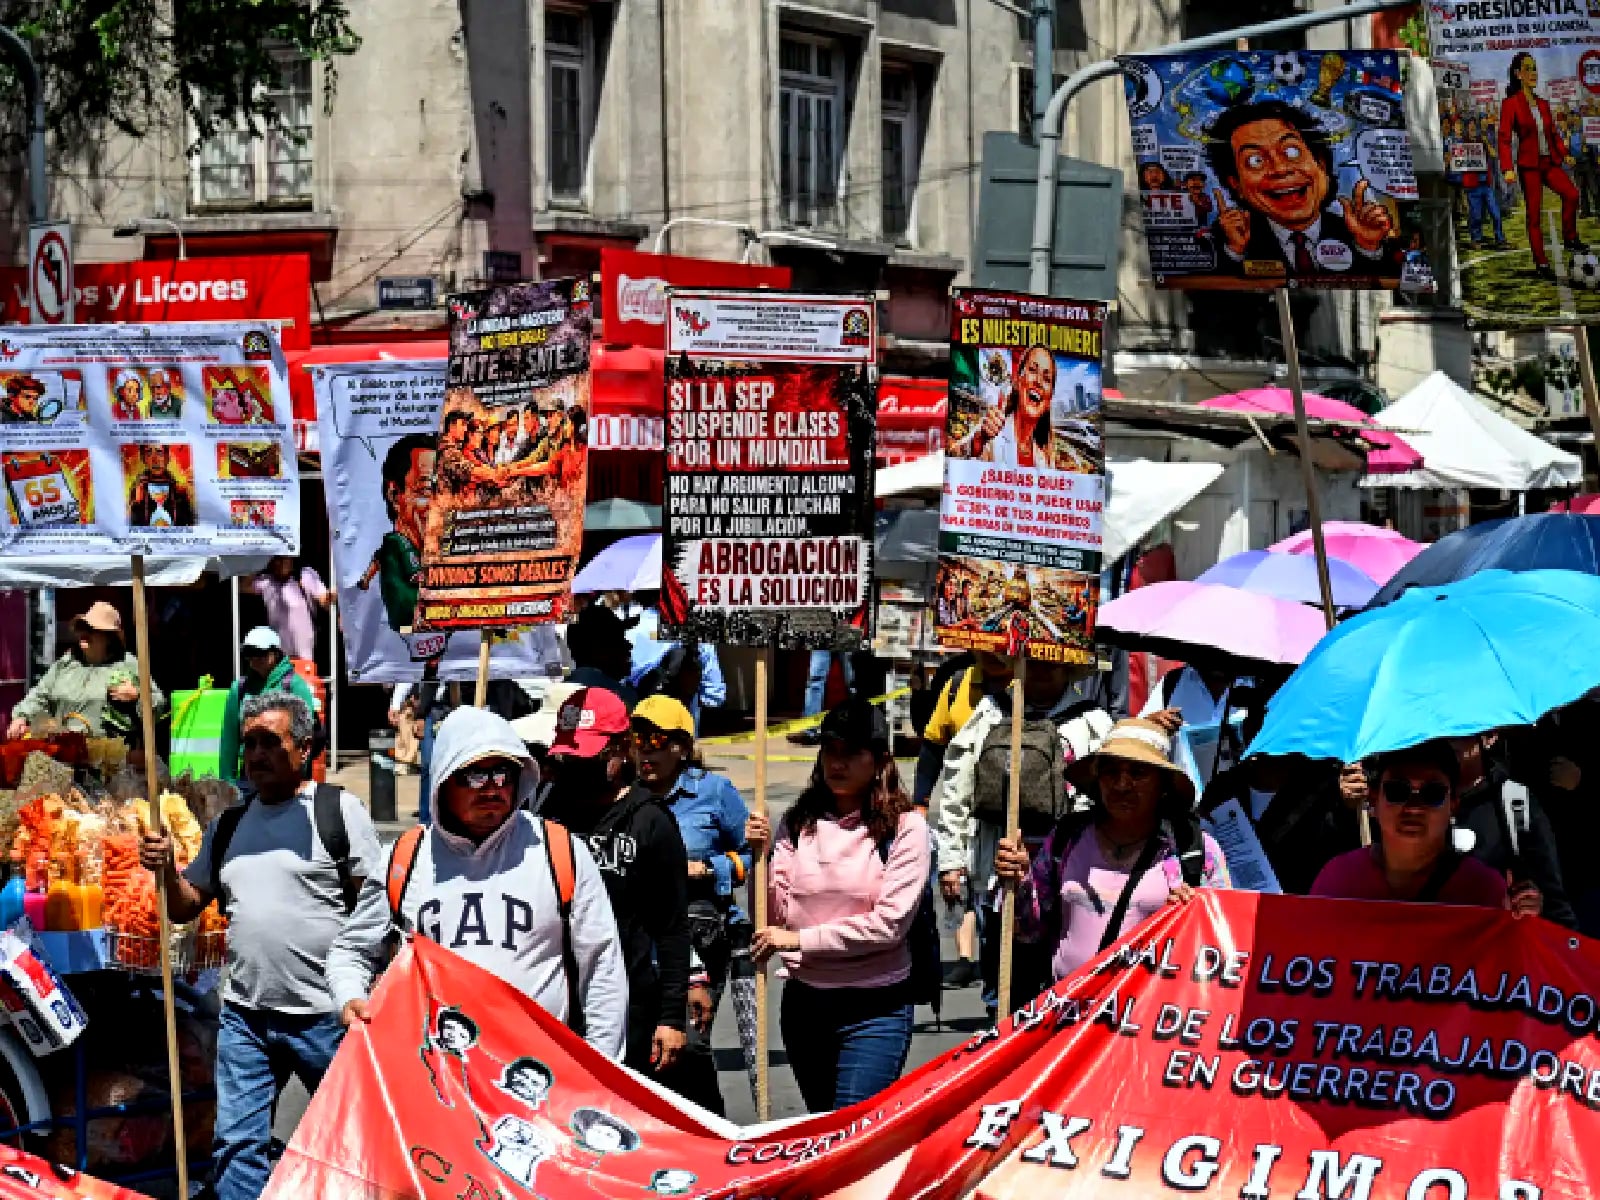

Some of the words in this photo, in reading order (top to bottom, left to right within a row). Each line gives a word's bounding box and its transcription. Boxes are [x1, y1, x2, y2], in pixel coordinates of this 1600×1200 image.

[108, 282, 126, 309] y
[134, 276, 248, 304] Licores
[961, 318, 980, 344] ES
[982, 319, 1048, 346] NUESTRO
[670, 382, 691, 411] SI
[700, 382, 727, 411] LA
[735, 382, 775, 411] SEP
[670, 411, 768, 439] SUSPENDE
[774, 411, 839, 438] CLASES
[671, 439, 711, 466] POR
[717, 439, 741, 466] UN
[748, 439, 849, 466] MUNDIAL...
[670, 475, 689, 493] NO
[692, 475, 718, 493] HAY
[720, 475, 799, 494] ARGUMENTO
[801, 475, 856, 493] ALGUNO
[981, 468, 1034, 488] ¿SABÍAS
[24, 478, 61, 507] 65
[670, 497, 706, 514] PARA
[711, 497, 730, 514] NO
[733, 497, 770, 514] SALIR
[774, 497, 784, 514] A
[787, 497, 841, 514] LUCHAR
[956, 485, 1015, 503] GOBIERNO
[1019, 492, 1033, 504] YA
[1035, 494, 1072, 510] PUEDE
[670, 516, 701, 536] POR
[705, 516, 721, 534] LA
[968, 517, 1001, 532] OBRAS
[1002, 520, 1014, 532] DE
[994, 504, 1009, 518] DE
[1011, 506, 1034, 521] TUS
[1035, 511, 1091, 529] AHORROS
[698, 537, 859, 575] ABROGACIÓN
[480, 563, 518, 584] SOMOS
[697, 578, 721, 605] ES
[728, 578, 752, 604] LA
[760, 575, 859, 605] SOLUCIÓN
[416, 634, 444, 656] SEP
[416, 892, 534, 952] GAP
[1195, 944, 1250, 984] DE
[1260, 955, 1338, 990] LOS
[1352, 960, 1600, 1029] TRABAJADO
[1156, 1003, 1211, 1040] DE
[1219, 1013, 1300, 1050] LOS
[1165, 1050, 1221, 1085] EN
[1231, 1059, 1456, 1113] GUERRERO
